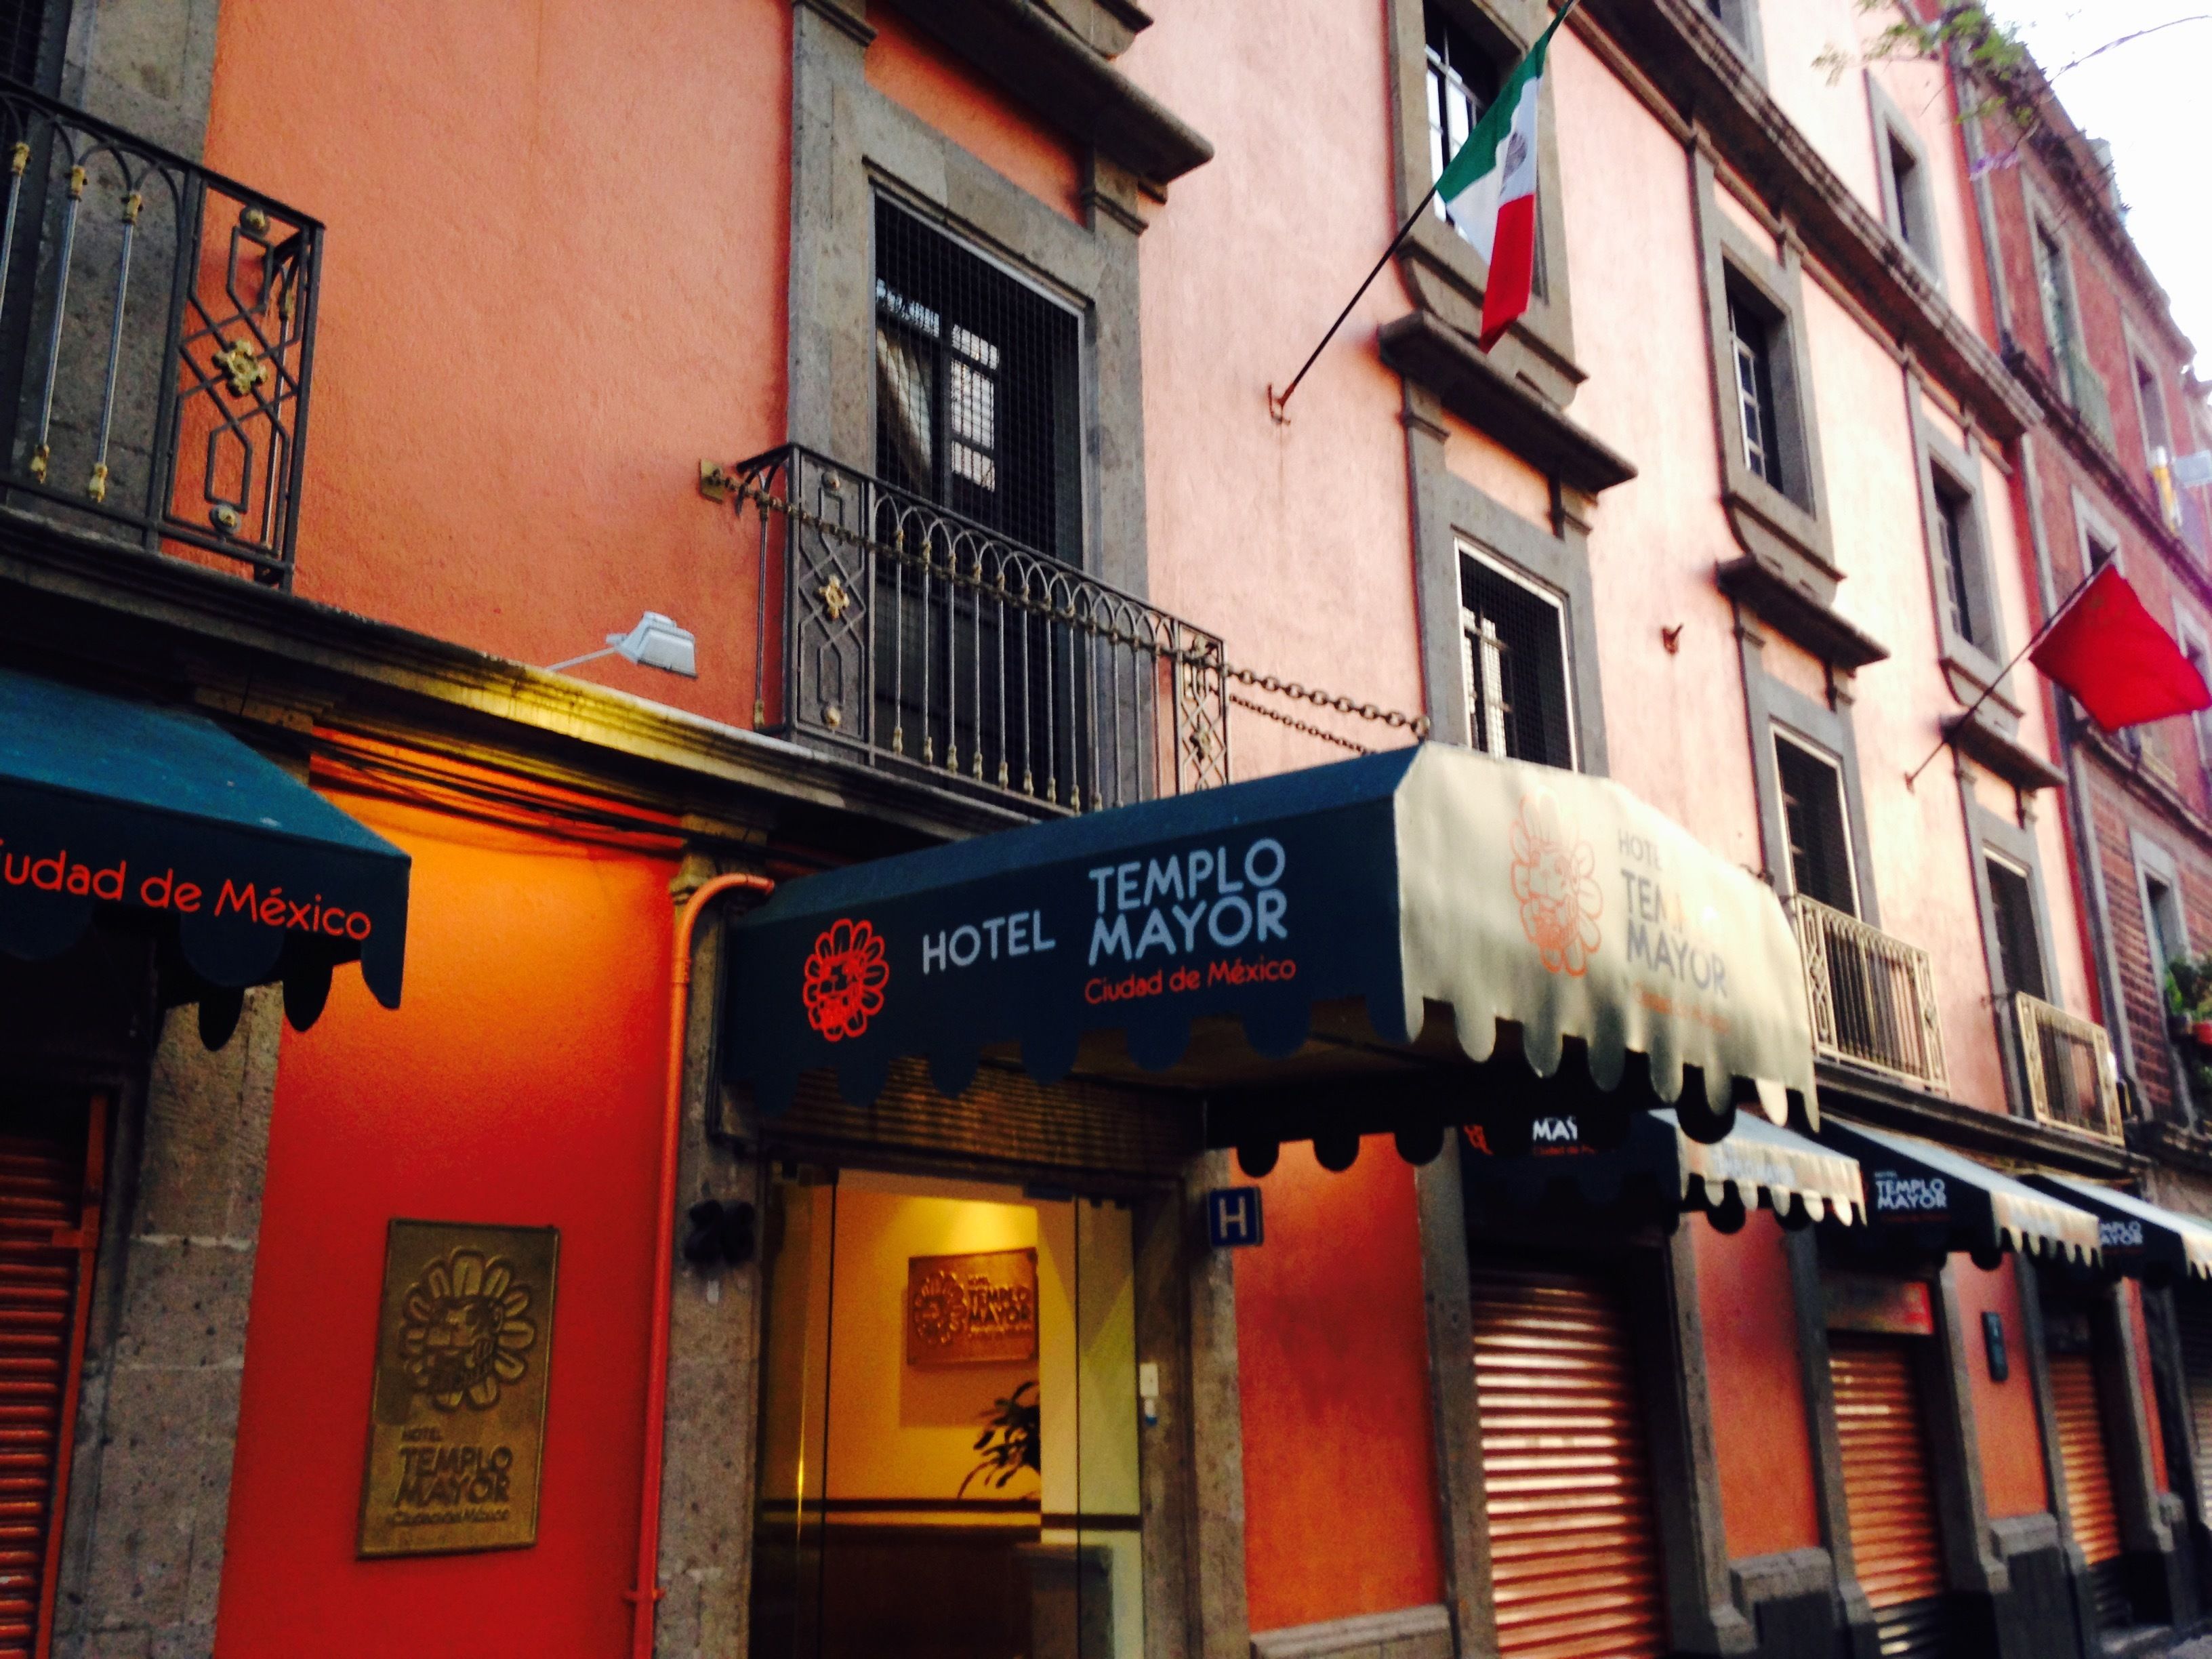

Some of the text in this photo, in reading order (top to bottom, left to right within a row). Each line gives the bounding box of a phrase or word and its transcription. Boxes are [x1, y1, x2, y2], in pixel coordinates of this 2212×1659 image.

[0, 838, 372, 940] udad de México
[1088, 837, 1286, 914] TEMPLO
[922, 910, 1056, 975] HOTEL
[1088, 888, 1288, 967] MAYOR
[1084, 955, 1296, 1005] Ciudad de México
[1626, 921, 1728, 999] MAYOR
[1218, 1196, 1248, 1239] H
[1877, 1191, 1948, 1210] MAYOR
[398, 1445, 513, 1476] TEMPLO
[391, 1471, 511, 1509] MAYOR
